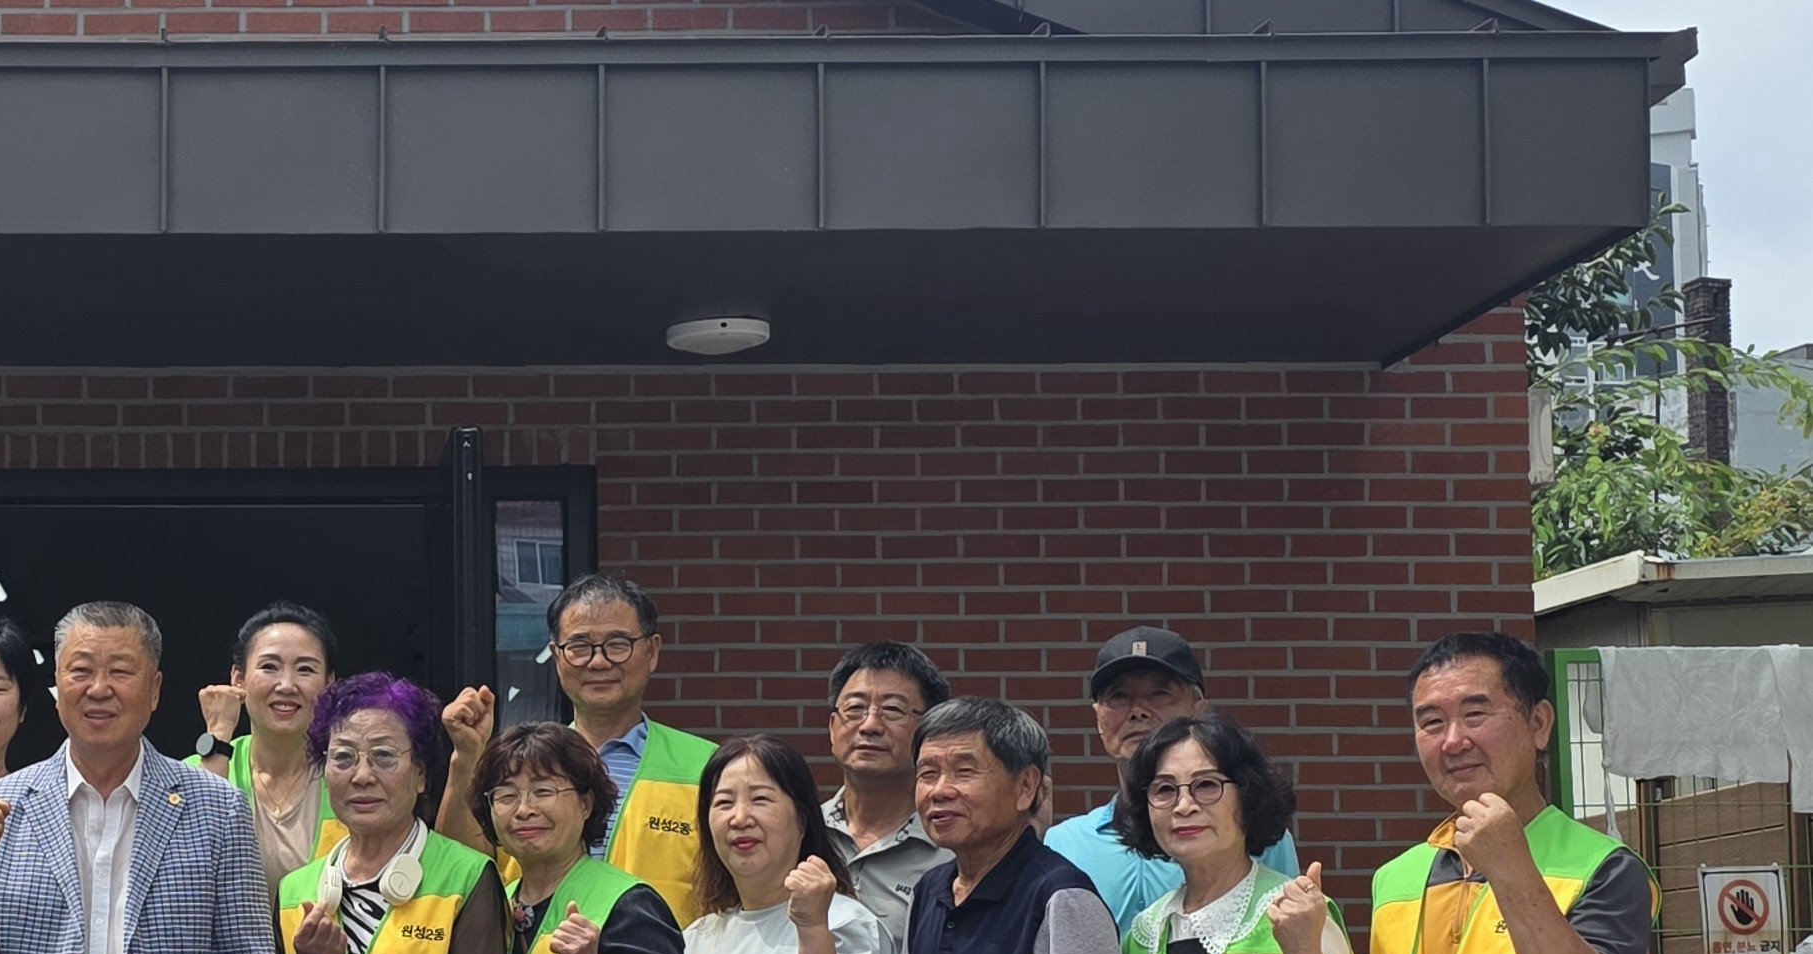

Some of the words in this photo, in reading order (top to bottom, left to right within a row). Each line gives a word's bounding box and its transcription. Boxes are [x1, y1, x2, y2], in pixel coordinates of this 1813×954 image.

[648, 815, 692, 836] 원성2동
[401, 923, 445, 942] 원성2동
[1759, 940, 1782, 952] 금지
